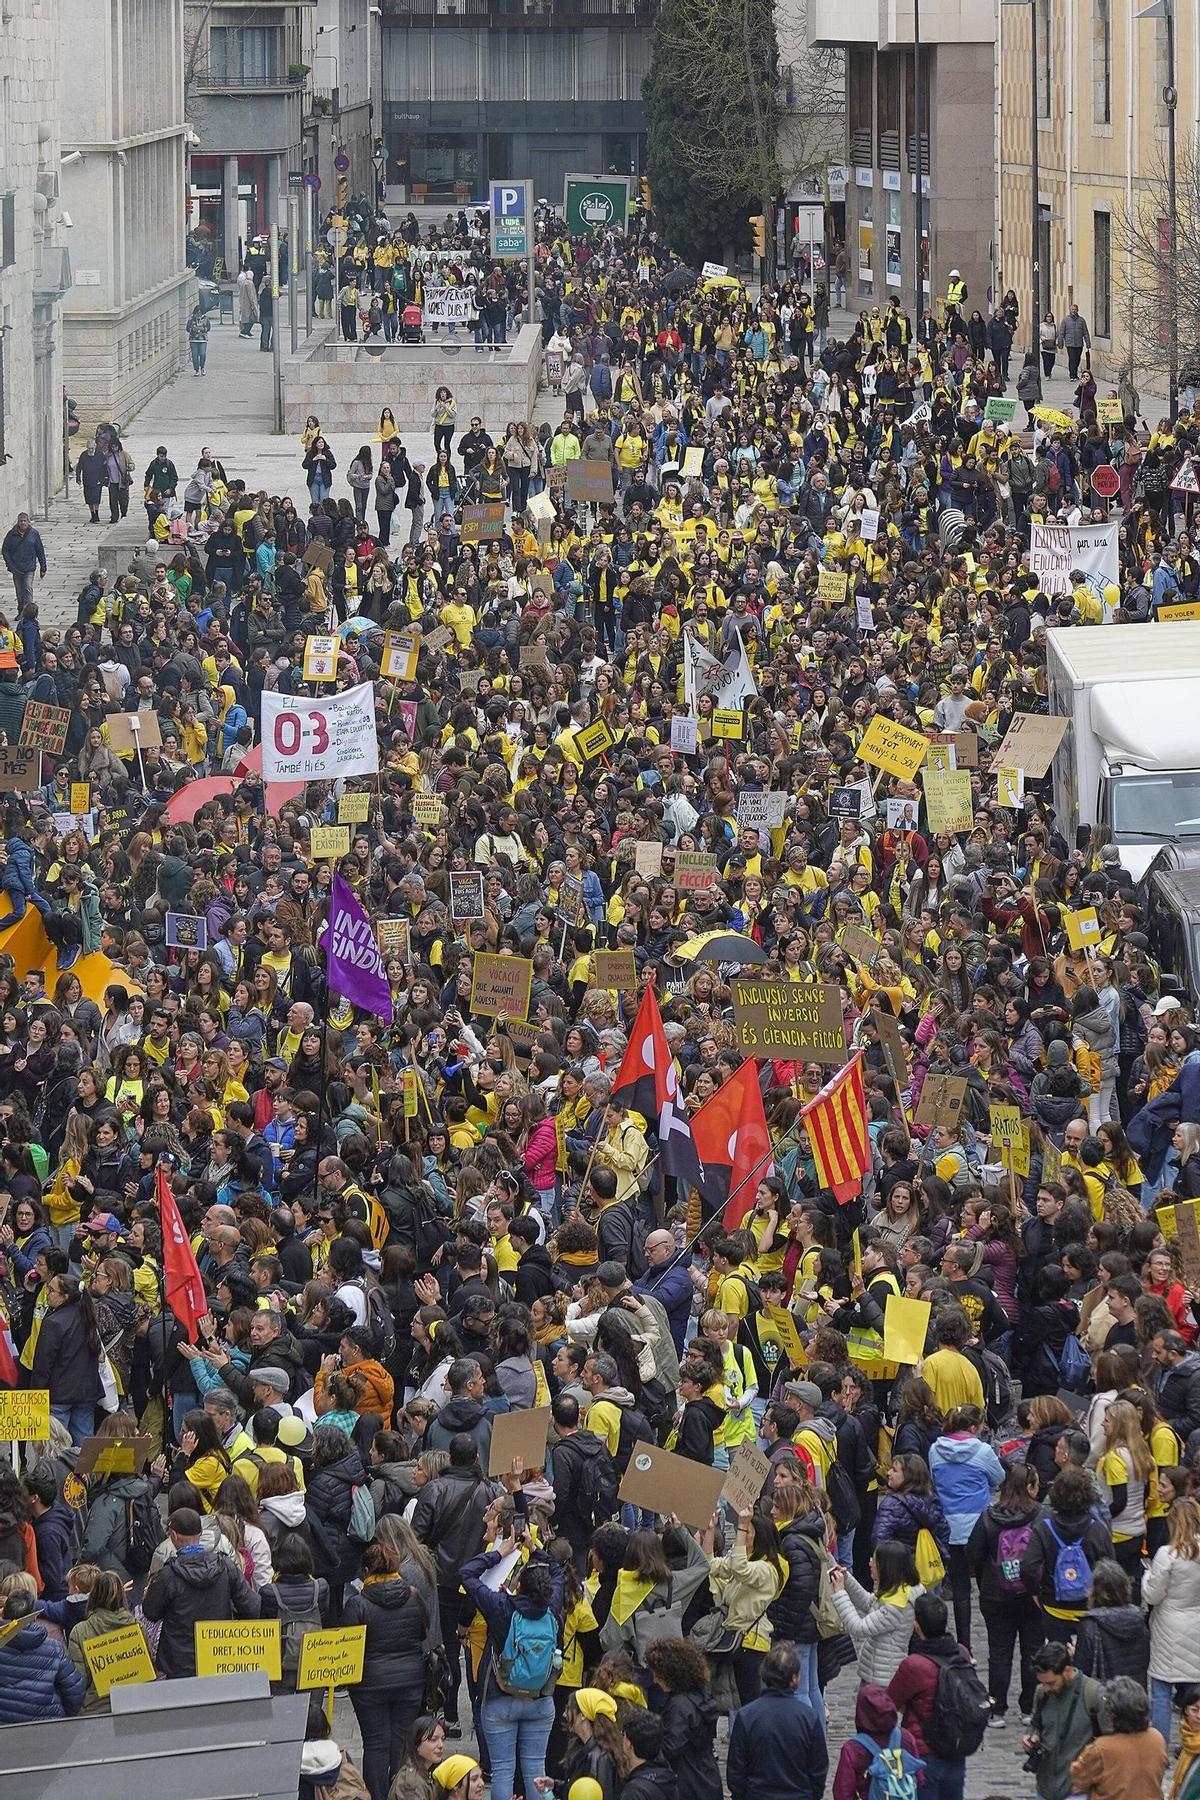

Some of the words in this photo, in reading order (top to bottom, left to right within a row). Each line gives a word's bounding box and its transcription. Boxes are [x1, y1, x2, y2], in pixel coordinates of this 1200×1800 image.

[394, 113, 420, 121] bulthaup
[501, 188, 518, 215] P
[498, 239, 519, 247] saba
[1033, 550, 1072, 570] EDUCACIÓ
[1174, 610, 1195, 618] VOLEM
[282, 697, 299, 708] EL
[1008, 716, 1027, 734] 27
[274, 711, 330, 756] 0-3
[876, 722, 891, 734] HO
[892, 731, 924, 751] APROVEM
[882, 737, 899, 750] TOT
[16, 747, 34, 760] NO
[865, 743, 889, 760] MENYS
[890, 753, 899, 763] EL
[900, 756, 918, 770] SOU
[274, 760, 302, 774] TAMBÉ
[489, 966, 520, 984] VOCACIÓ
[475, 982, 487, 992] QUE
[474, 995, 497, 1007] AQUESTA
[737, 983, 788, 1006] INCLUSIÓ
[792, 988, 825, 1004] SENSE
[768, 1005, 820, 1024] INVERSIÓ
[742, 1021, 756, 1045] ÉS
[11, 1391, 47, 1406] RECURSOS
[28, 1416, 42, 1428] DIU
[201, 1626, 250, 1639] L'EDUCACIÓ
[251, 1625, 261, 1638] ÉS
[263, 1627, 274, 1638] UN
[237, 1645, 252, 1656] NO
[253, 1645, 265, 1656] UN
[90, 1655, 106, 1674] NO
[106, 1654, 114, 1665] ÉS
